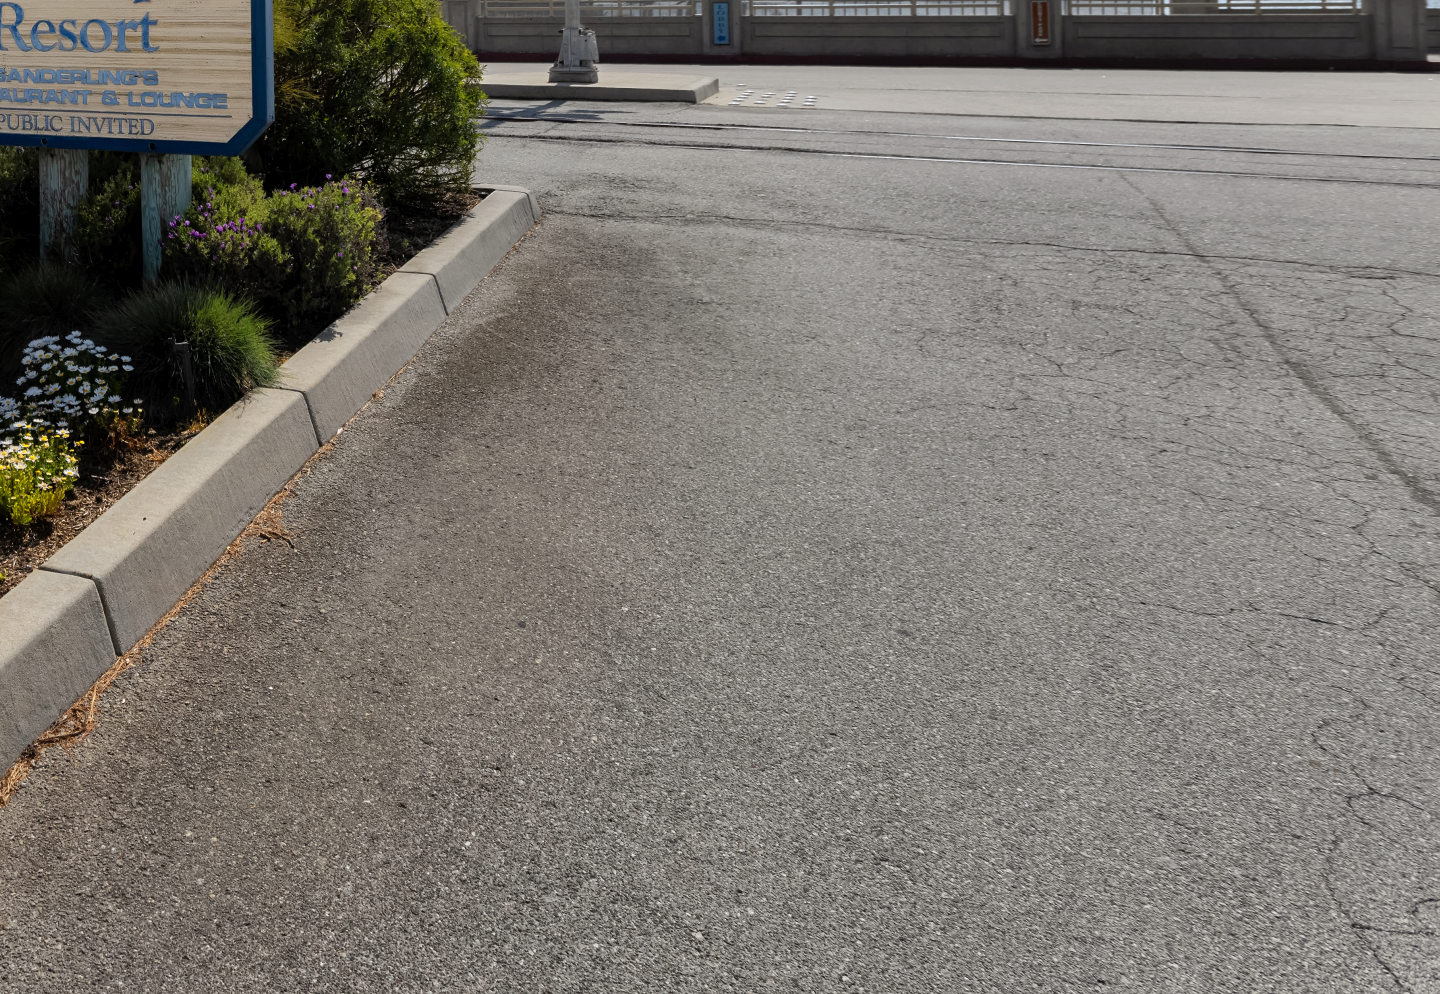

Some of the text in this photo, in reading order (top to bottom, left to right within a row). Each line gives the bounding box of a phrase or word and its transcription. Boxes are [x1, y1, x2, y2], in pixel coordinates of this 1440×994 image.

[716, 4, 726, 34] LOBBY
[101, 90, 120, 106] &
[127, 91, 229, 109] LOUNGE
[70, 116, 155, 136] INVITED
